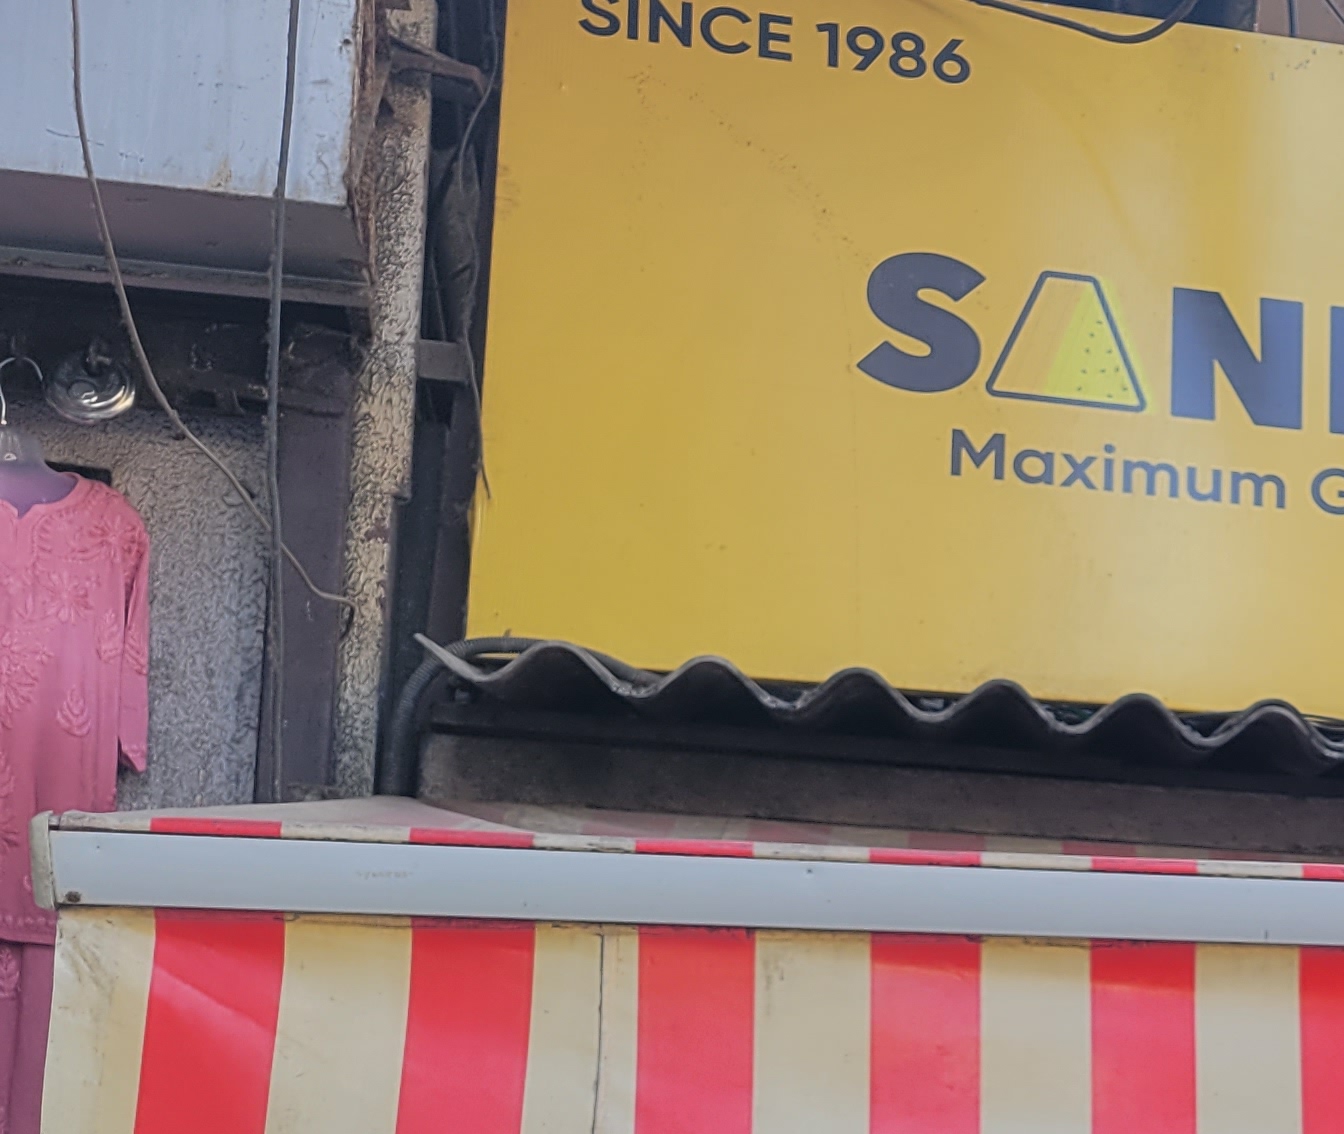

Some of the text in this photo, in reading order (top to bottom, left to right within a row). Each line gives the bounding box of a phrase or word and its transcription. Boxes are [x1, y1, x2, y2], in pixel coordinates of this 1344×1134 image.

[578, 0, 971, 84] SINCE 1986
[950, 429, 1287, 510] Maximum
